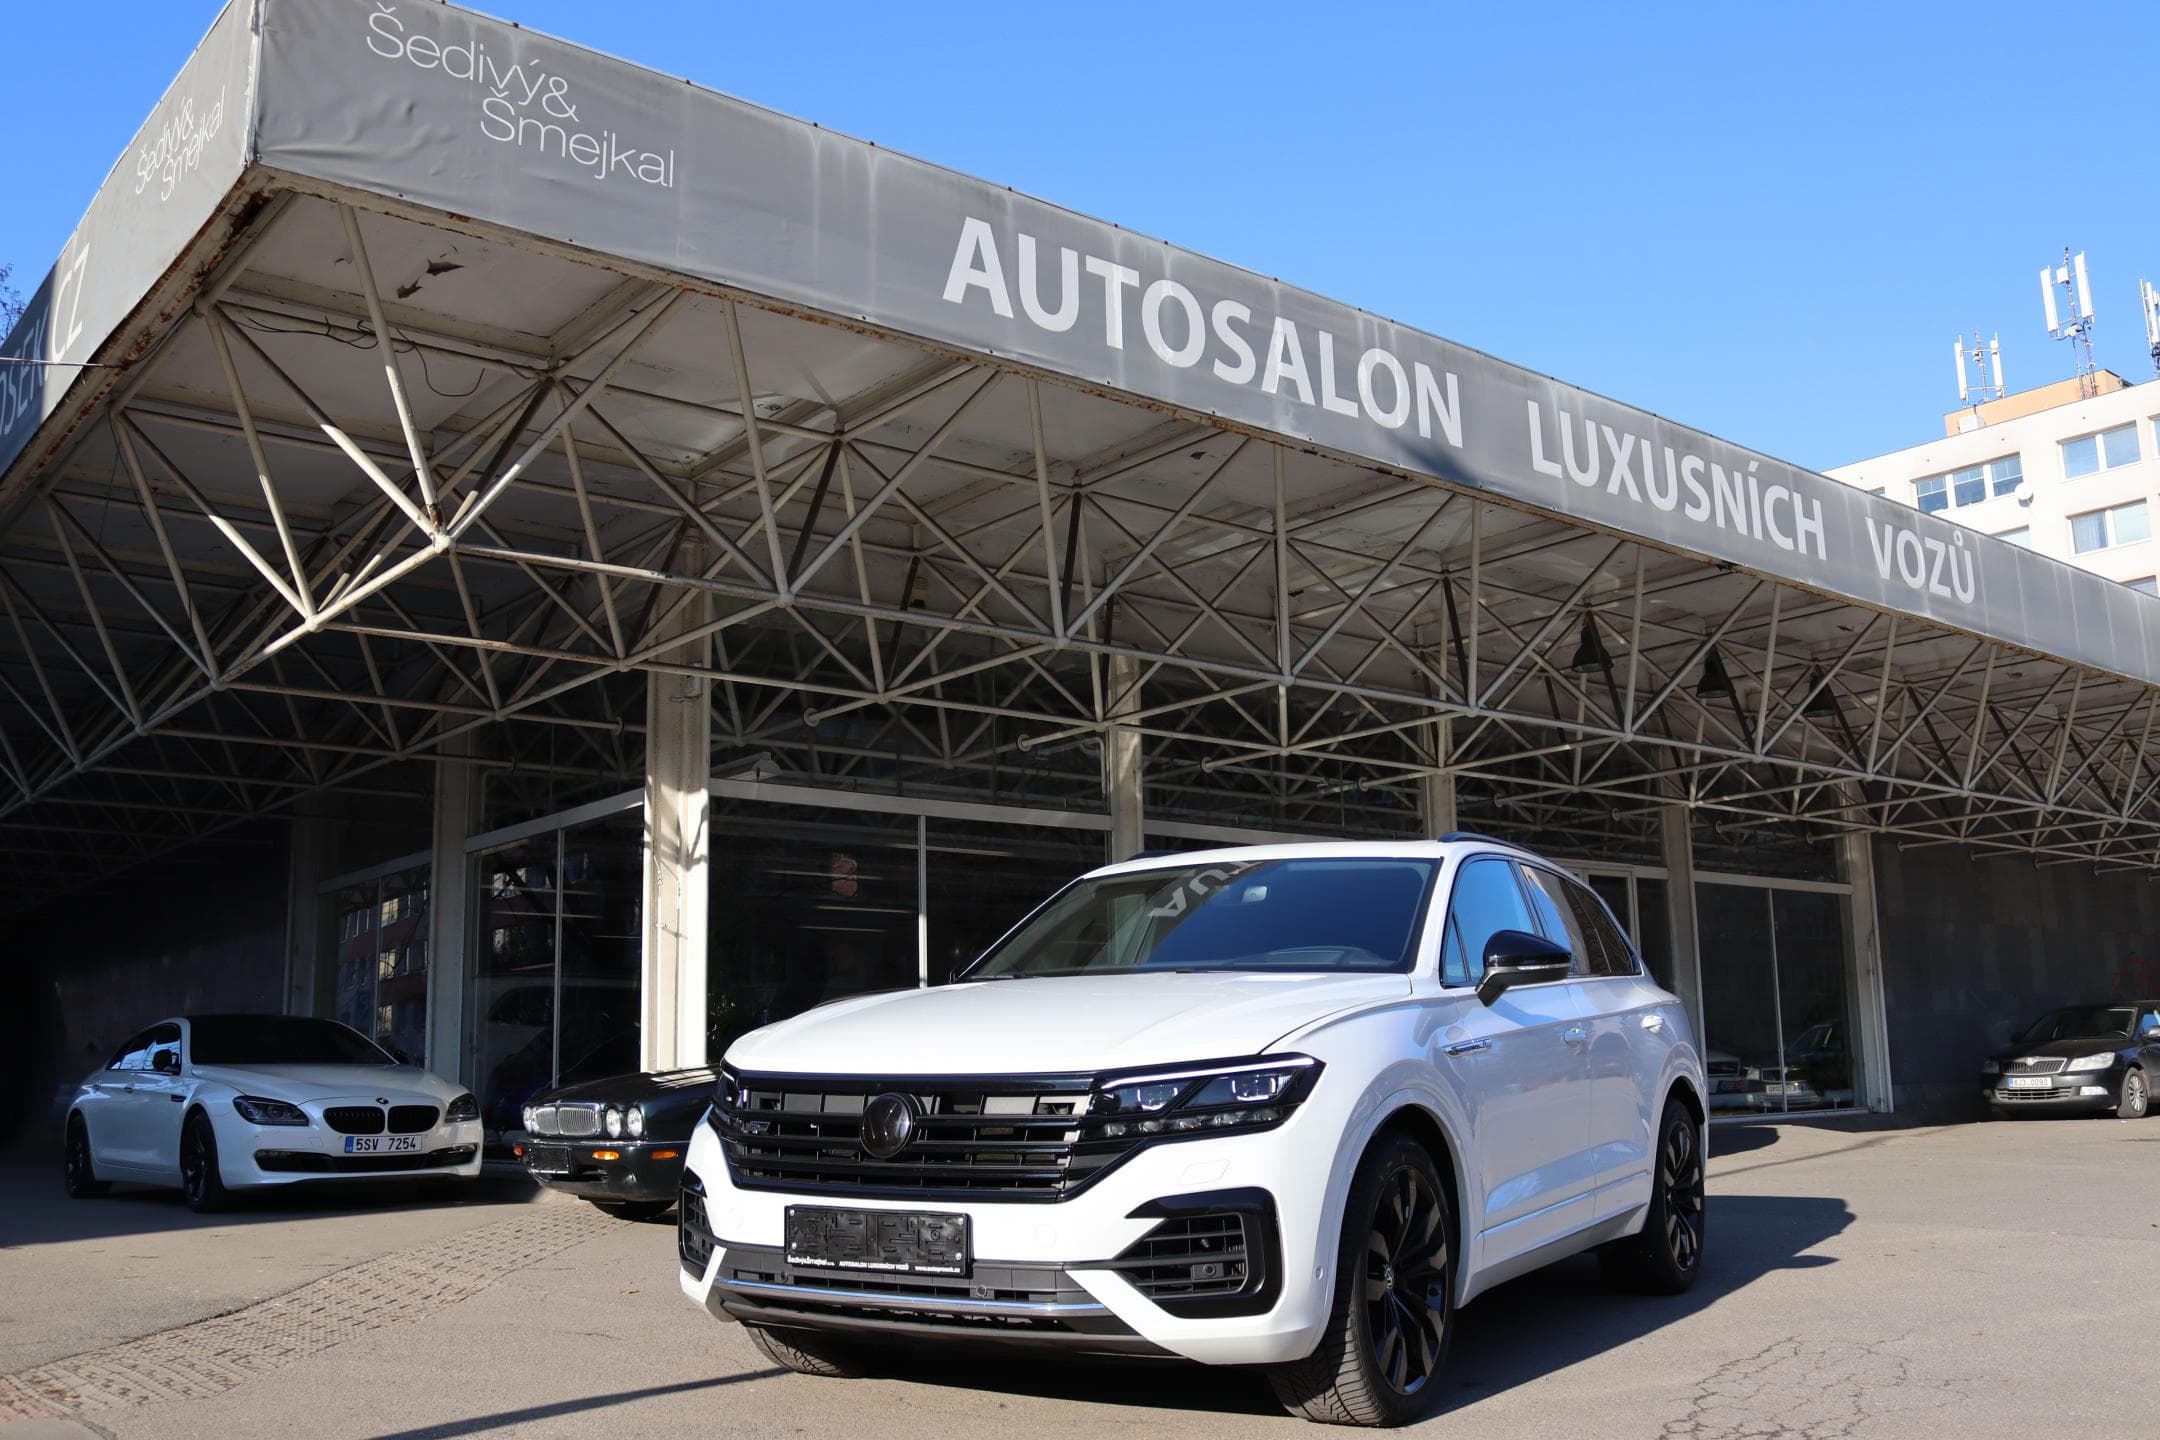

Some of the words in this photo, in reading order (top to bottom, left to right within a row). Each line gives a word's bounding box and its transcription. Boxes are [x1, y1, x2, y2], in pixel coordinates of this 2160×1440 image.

[366, 1, 580, 122] Šedivý&
[161, 85, 226, 202] Šmejkal
[480, 86, 674, 188] Šmejkal
[942, 216, 1463, 449] AUTOSALON
[1528, 400, 1827, 561] LUXUSNÍCH
[1865, 516, 1977, 605] VOZŮ
[356, 1137, 379, 1151] 5SV
[388, 1136, 416, 1150] 7254
